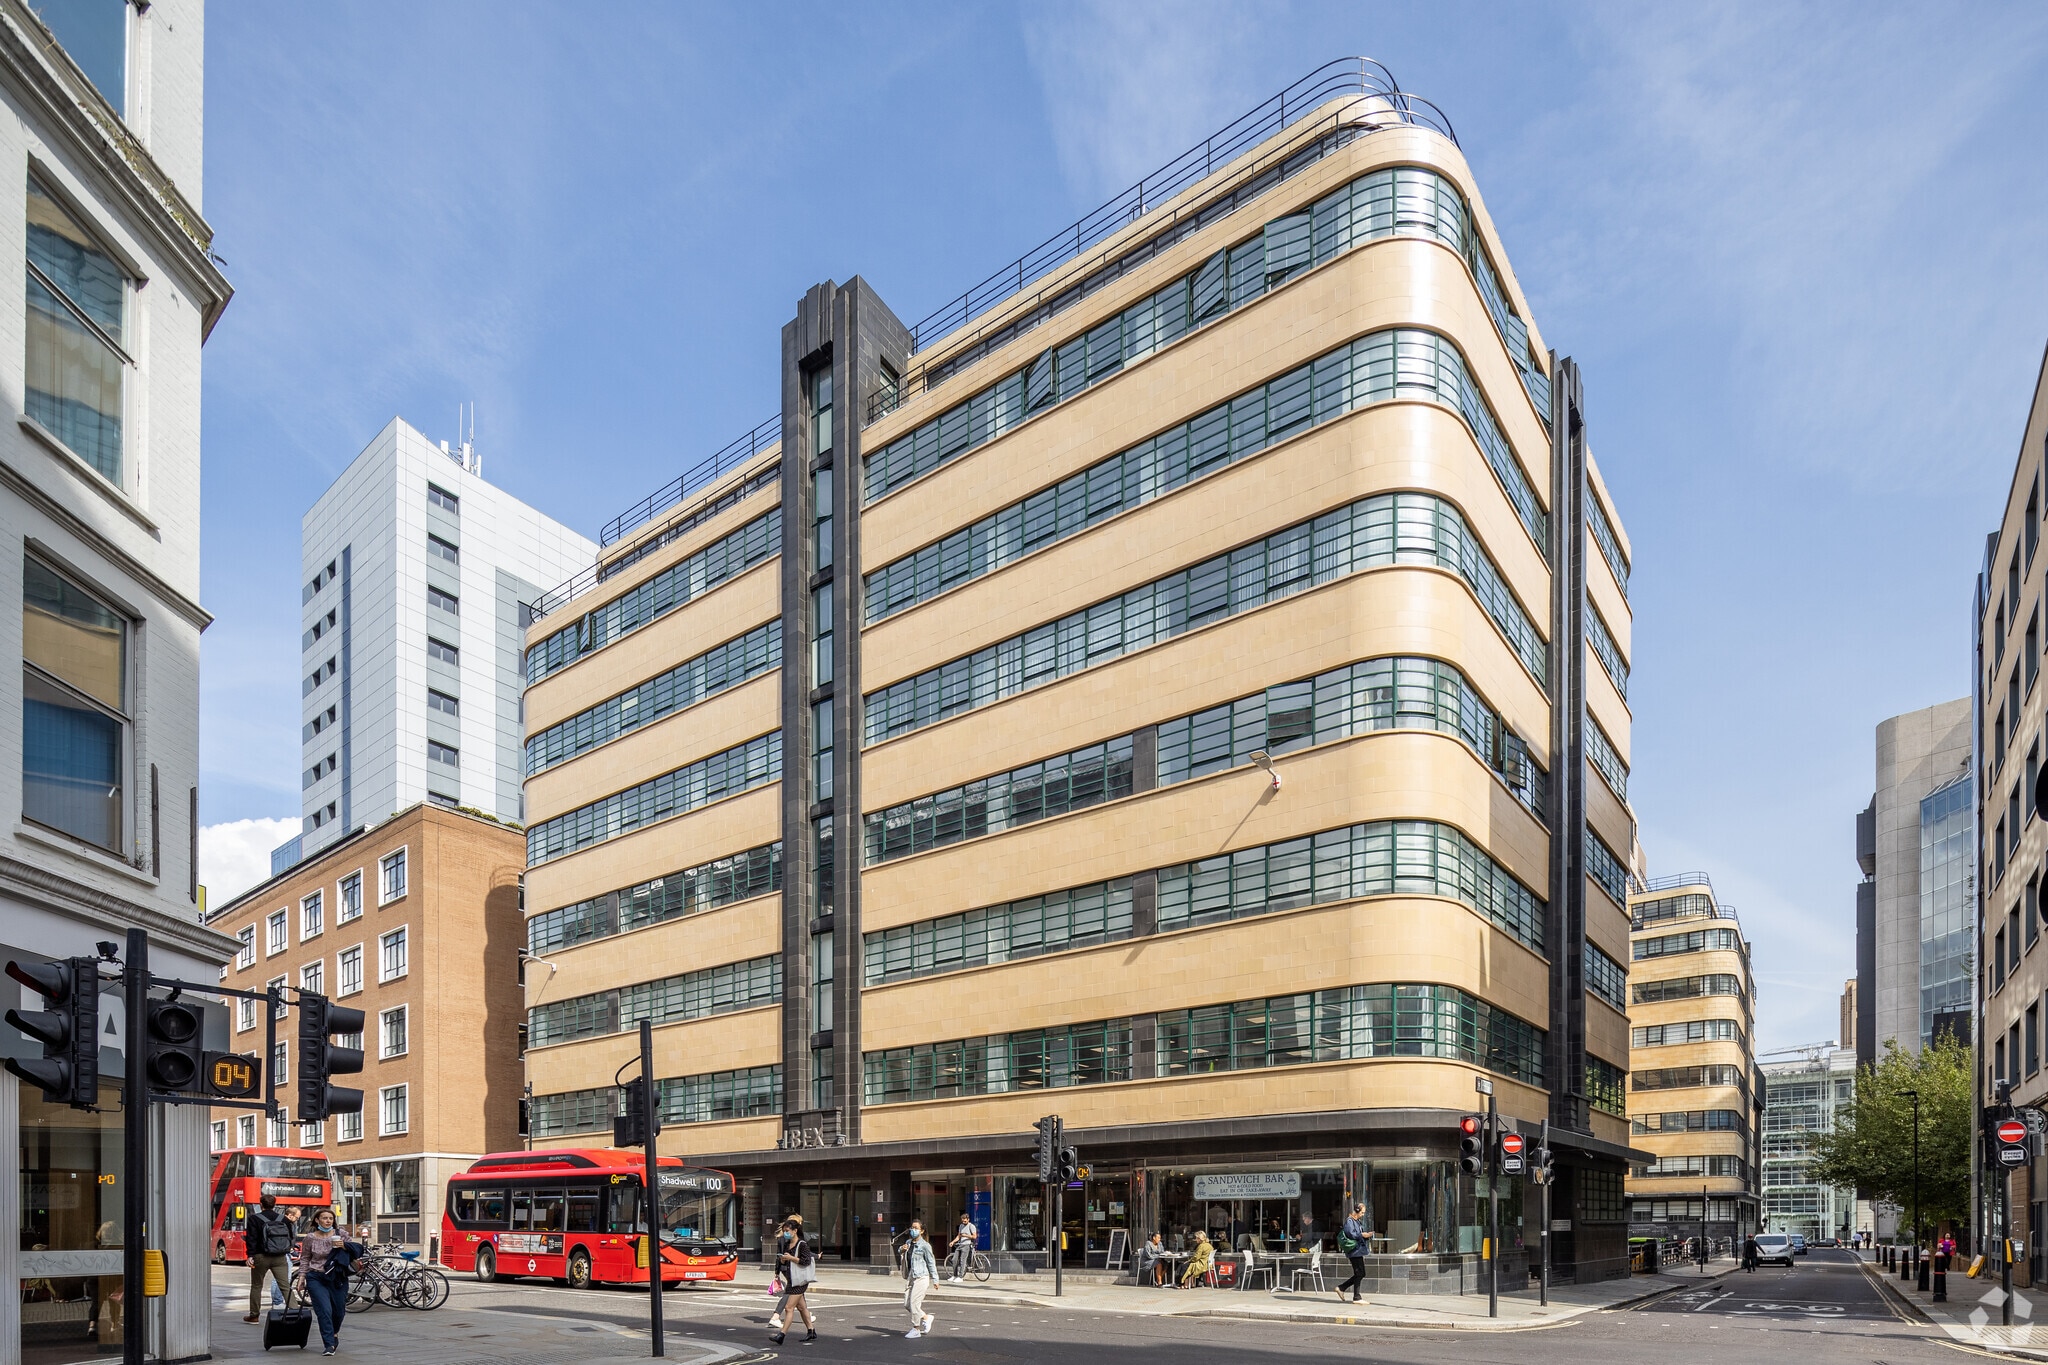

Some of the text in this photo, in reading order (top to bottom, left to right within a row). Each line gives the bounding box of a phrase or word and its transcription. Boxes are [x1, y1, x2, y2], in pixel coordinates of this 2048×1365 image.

[215, 1063, 250, 1088] 04
[784, 1127, 825, 1150] IBEX
[1078, 1168, 1089, 1178] 04
[661, 1176, 721, 1190] Shadwell 100
[1208, 1174, 1285, 1185] SANDWICH BAR
[266, 1184, 320, 1194] Nunhead 78
